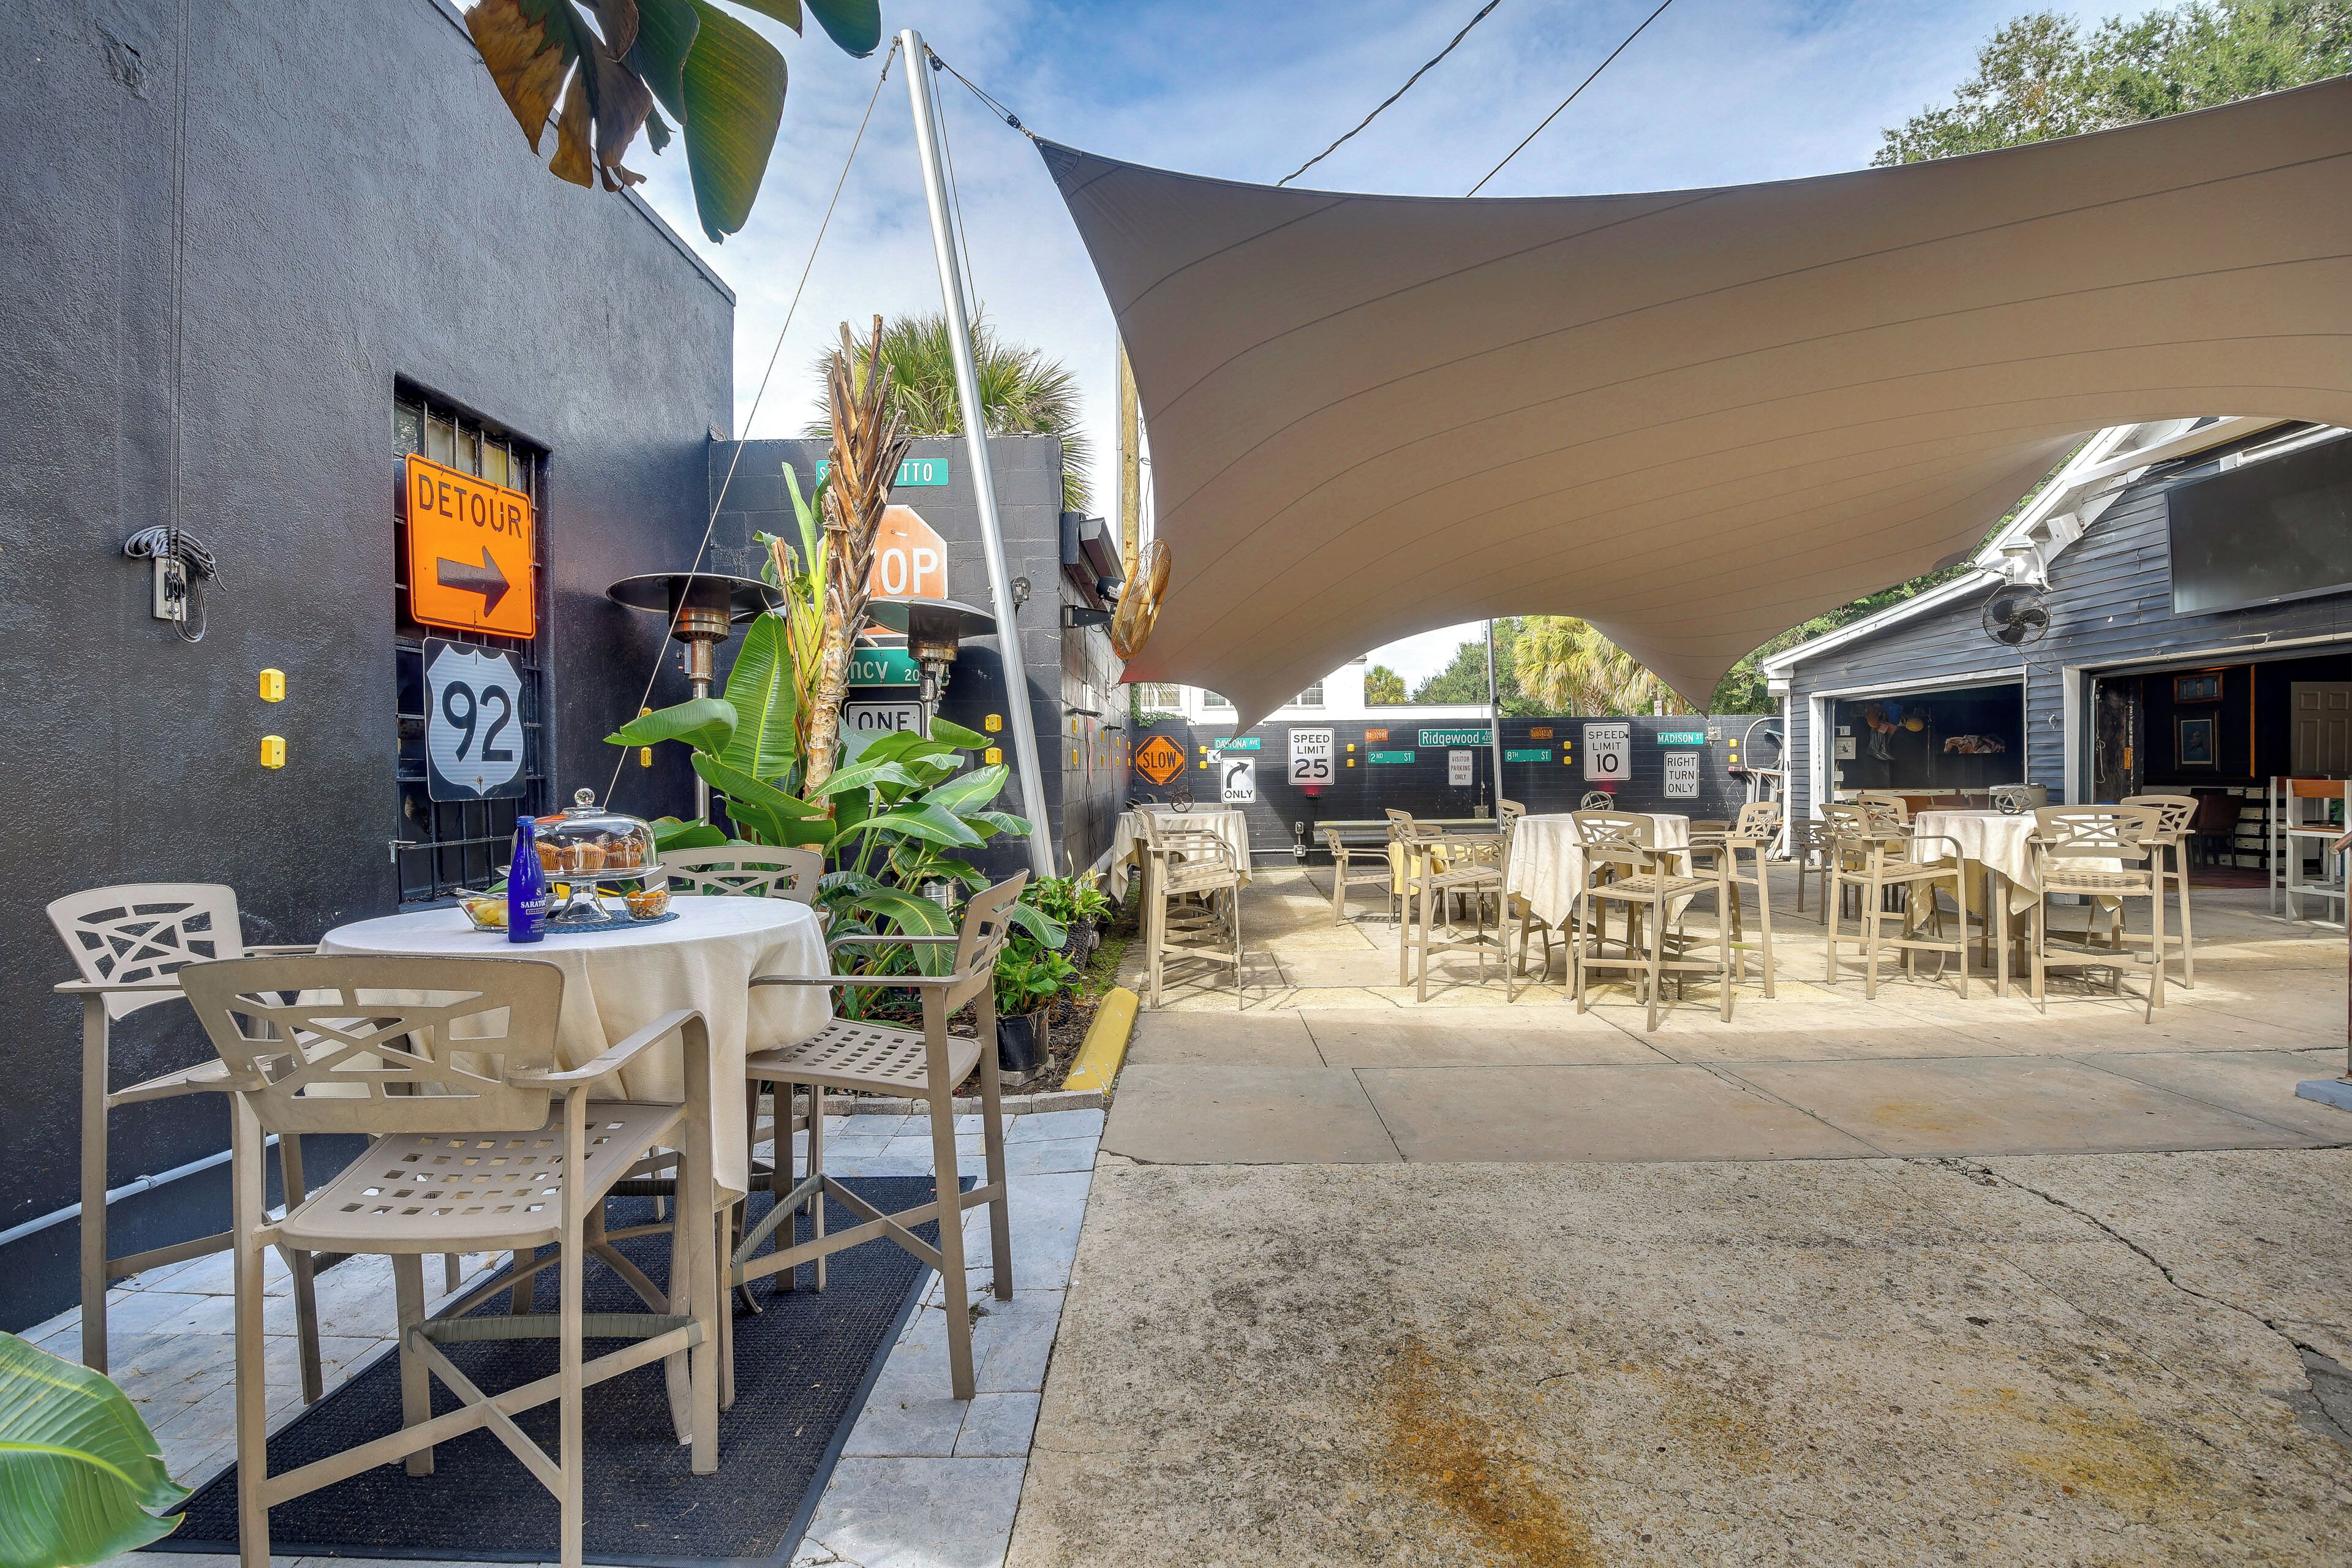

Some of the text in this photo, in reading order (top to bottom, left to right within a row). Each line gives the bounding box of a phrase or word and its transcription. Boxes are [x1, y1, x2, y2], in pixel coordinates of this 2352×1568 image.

[418, 473, 522, 538] DETOUR
[442, 680, 513, 763] 92
[1294, 734, 1330, 743] SPEED
[1422, 731, 1479, 745] Ridgewood
[1588, 731, 1626, 739] SPEED
[1658, 733, 1694, 743] MADISON
[1297, 745, 1325, 754] LIMIT
[1593, 742, 1621, 750] LIMIT
[1142, 752, 1177, 769] SLOW
[1370, 753, 1412, 762] 2ND ST
[1507, 751, 1549, 760] 8TH ST
[1596, 753, 1619, 773] 10
[1667, 757, 1696, 767] RIGHT
[1294, 758, 1329, 778] 25
[1668, 770, 1695, 780] TURN
[1668, 783, 1695, 793] ONLY
[1224, 790, 1253, 799] ONLY
